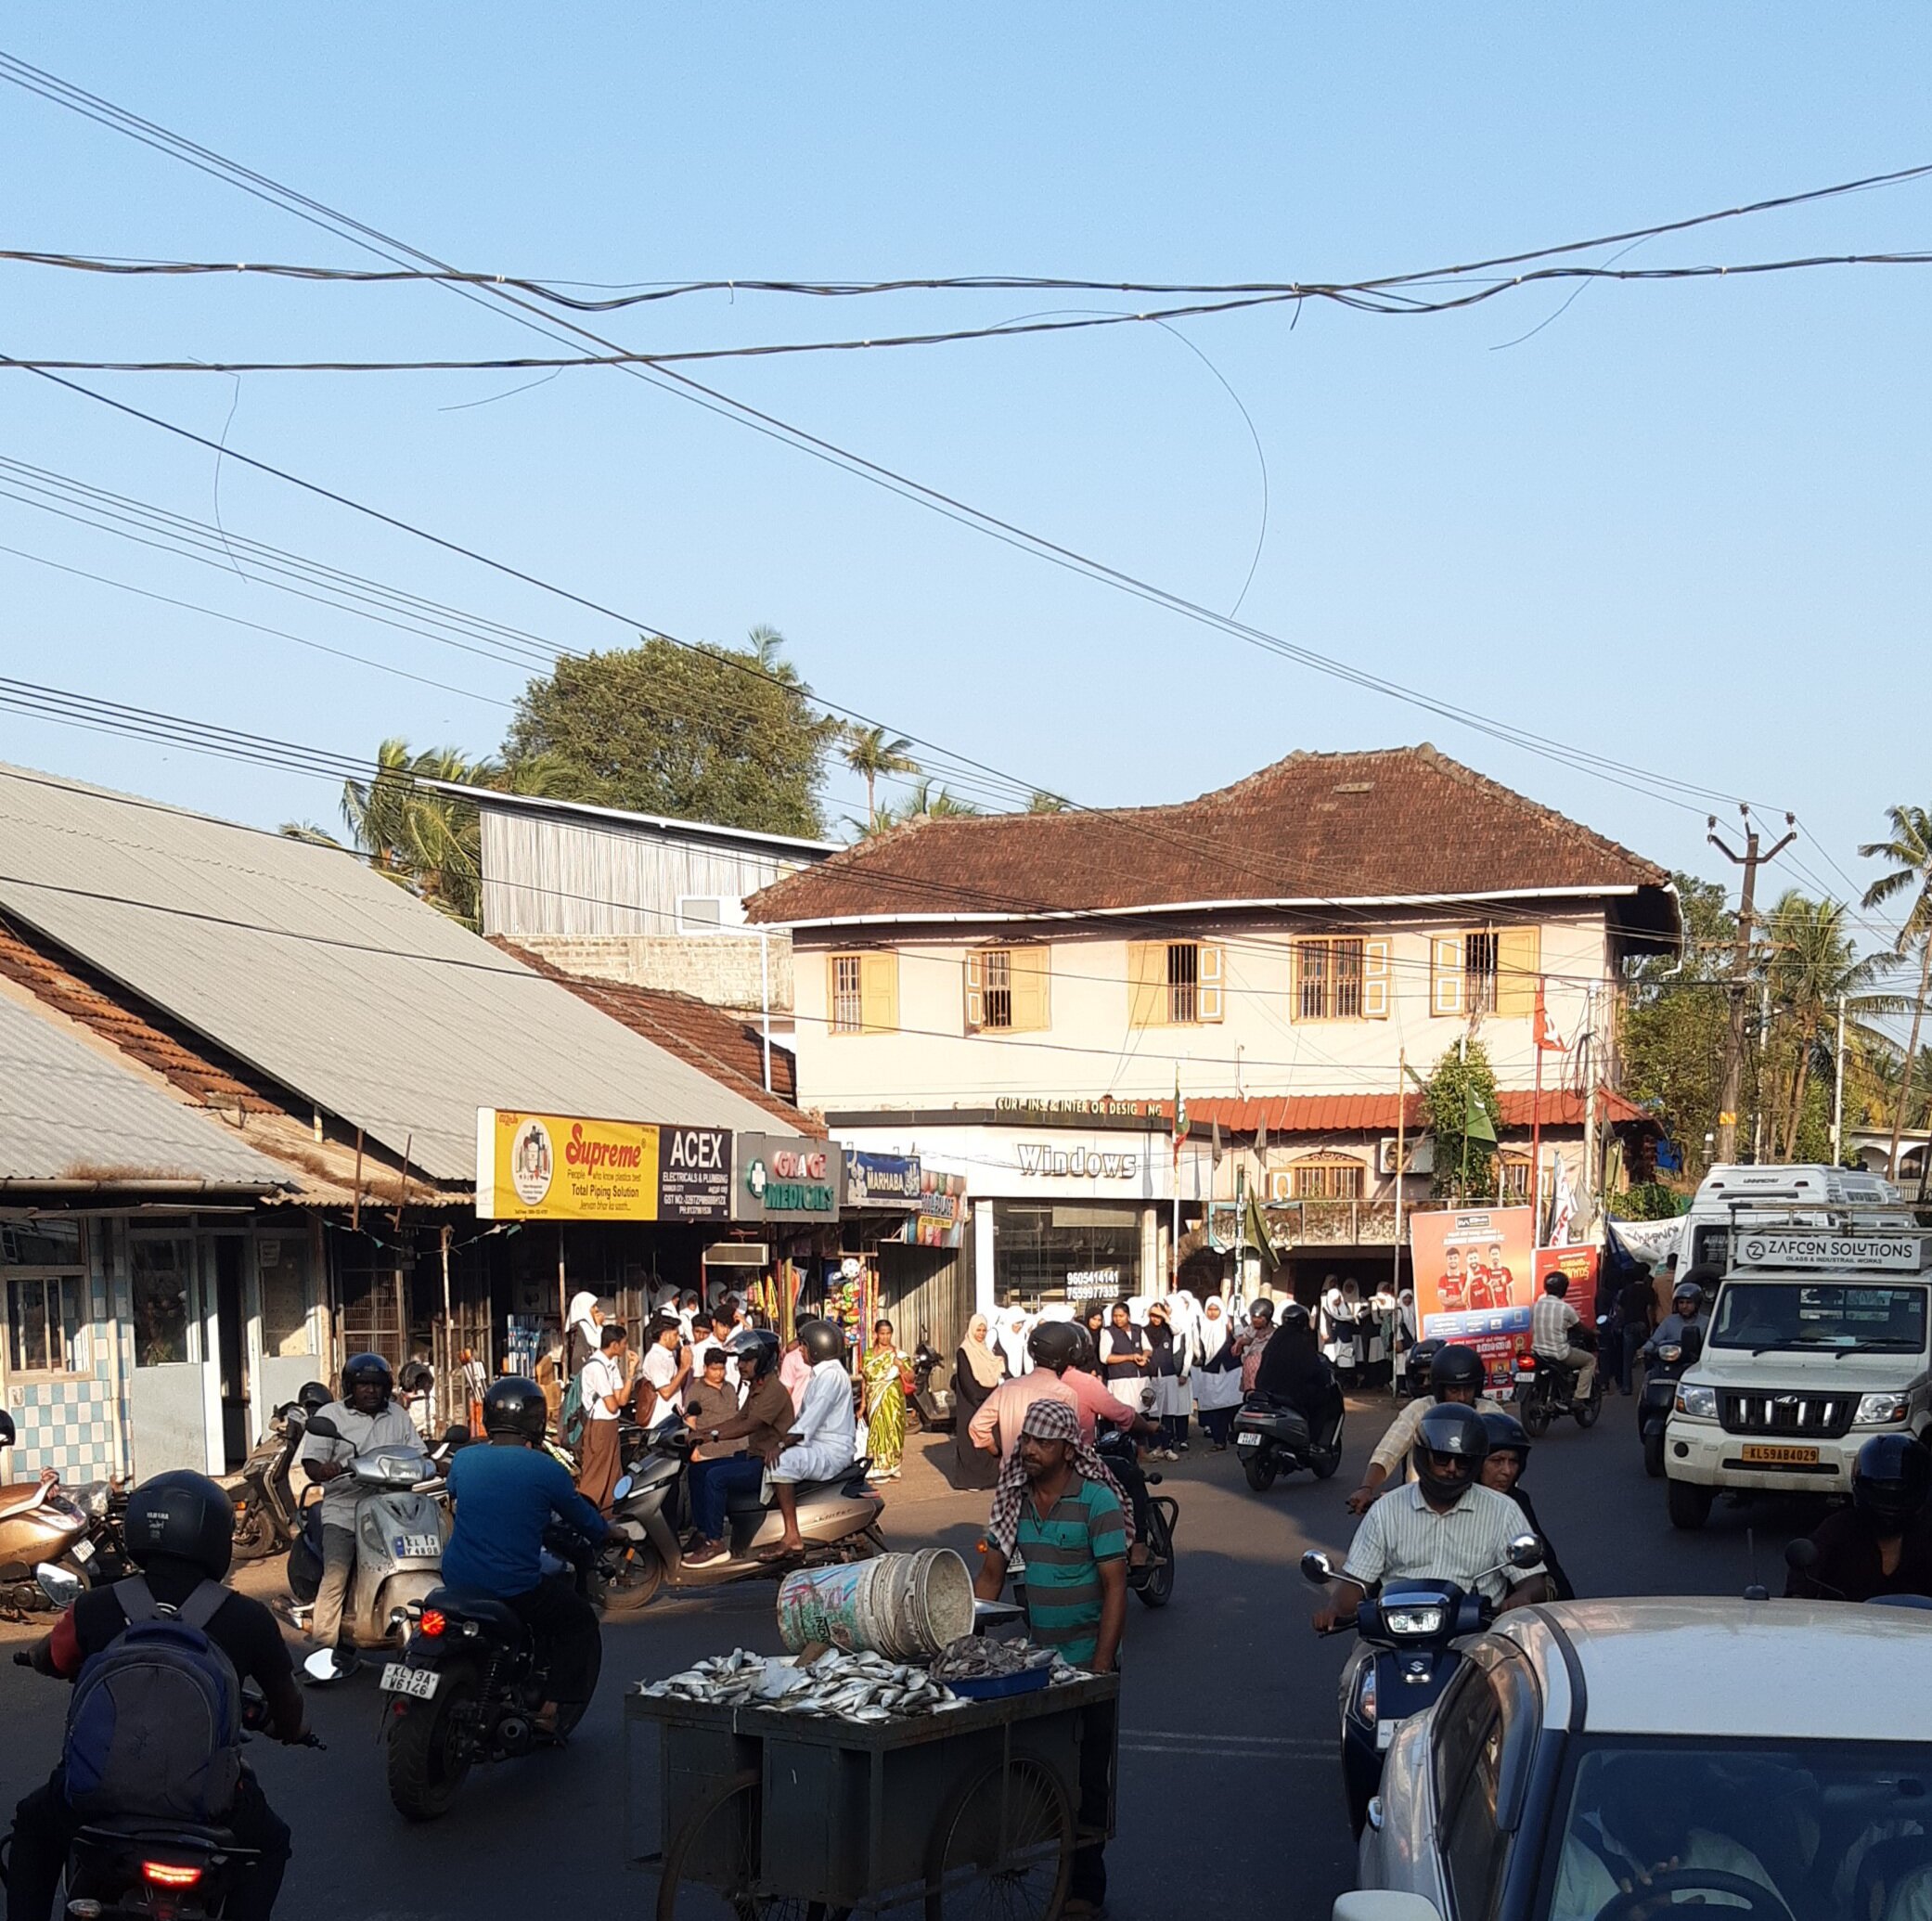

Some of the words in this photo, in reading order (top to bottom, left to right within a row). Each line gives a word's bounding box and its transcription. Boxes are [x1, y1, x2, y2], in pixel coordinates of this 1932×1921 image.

[566, 1123, 641, 1176] Supreme
[670, 1130, 723, 1168] ACEX
[774, 1150, 826, 1180] GRACE
[1017, 1143, 1137, 1179] Windows
[567, 1169, 586, 1180] People
[663, 1171, 698, 1183] ELECTRICALS
[702, 1173, 728, 1184] PLUMBING
[867, 1171, 904, 1191] MARHABA
[572, 1183, 588, 1196] Total
[590, 1184, 611, 1200] Piping
[612, 1185, 638, 1198] Solution
[765, 1184, 833, 1211] MEDICALS
[1067, 1270, 1119, 1285] 9605414141
[1067, 1284, 1119, 1299] 7559977333
[1750, 1448, 1817, 1462] KL59AB4029
